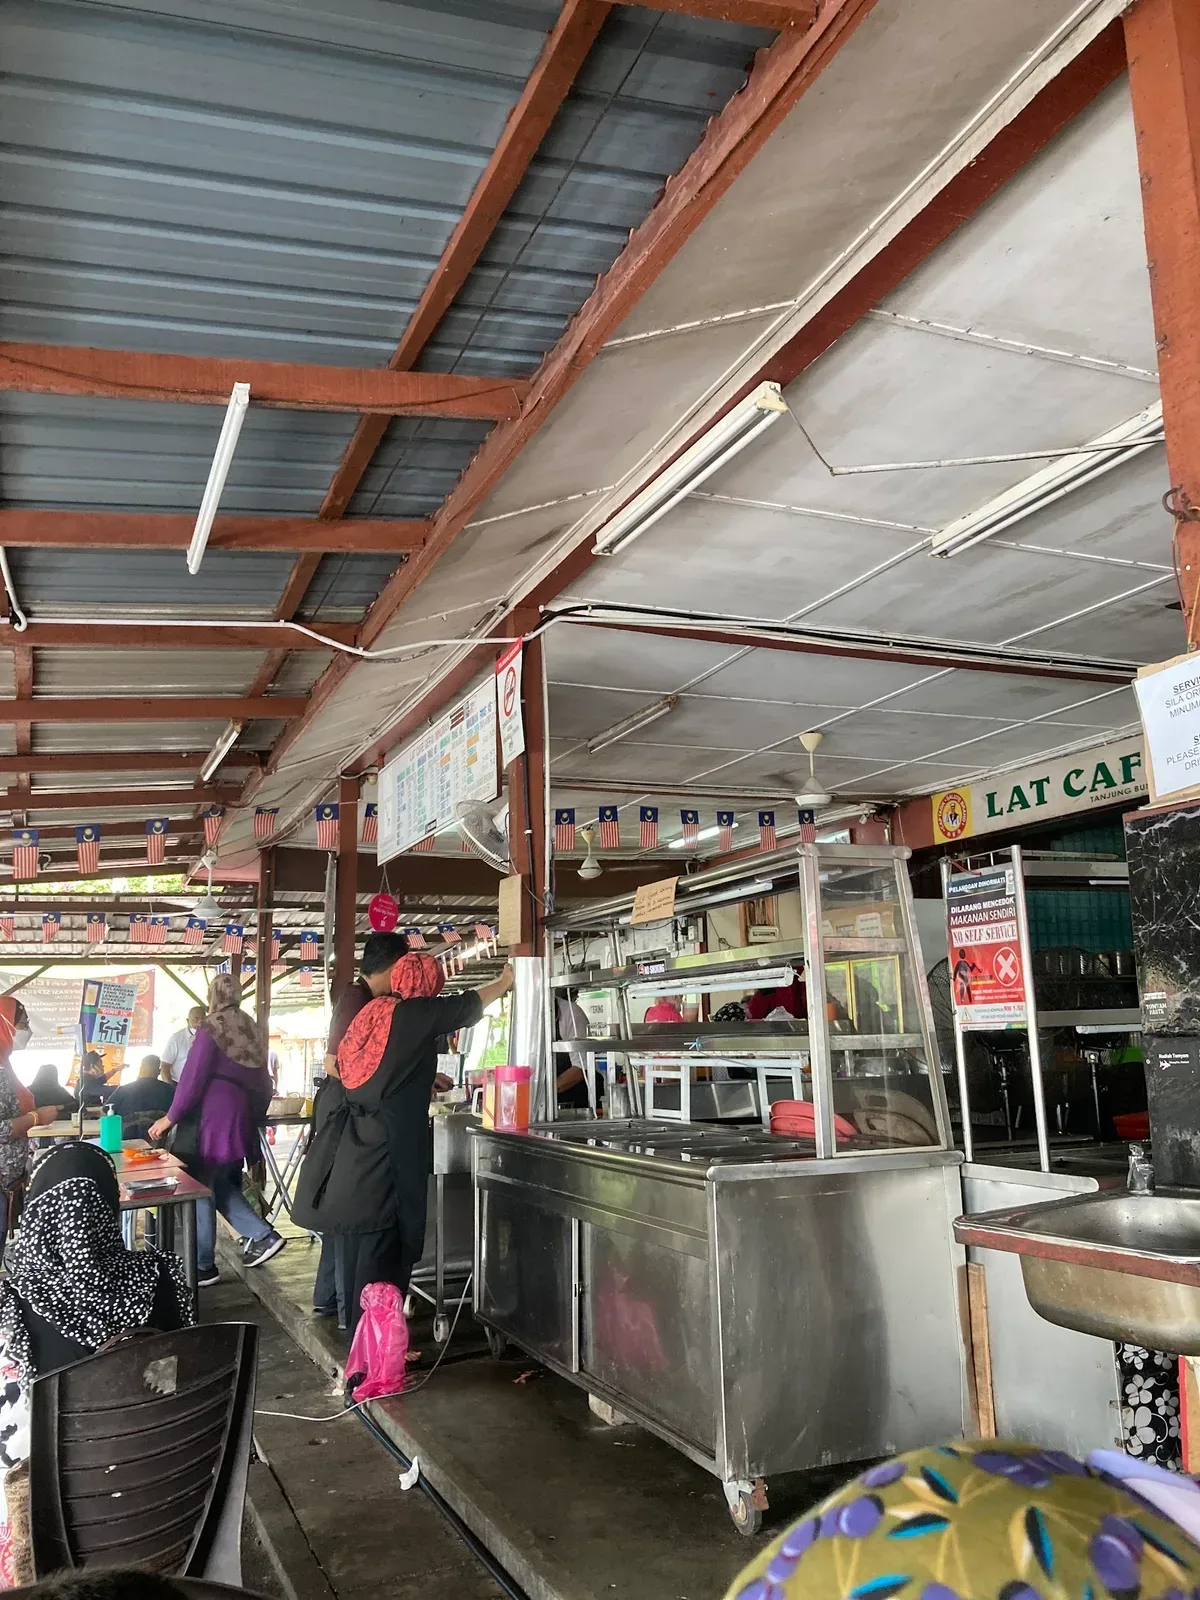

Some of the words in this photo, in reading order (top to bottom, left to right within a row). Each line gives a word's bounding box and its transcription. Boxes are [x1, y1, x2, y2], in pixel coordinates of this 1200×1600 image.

[1165, 695, 1185, 709] SILA
[1166, 746, 1199, 765] PLEASE
[986, 777, 1050, 818] LAT
[1063, 752, 1142, 798] CAF
[1090, 787, 1132, 803] TANJUNG
[949, 881, 978, 893] PELANGGAN
[951, 902, 982, 914] DILARANG
[982, 897, 1015, 908] MENCEDOK
[950, 911, 989, 926] MAKANAN
[989, 907, 1016, 921] SENDIRI
[953, 930, 964, 944] NO
[964, 928, 983, 942] SELF
[985, 923, 1017, 941] SERVICE
